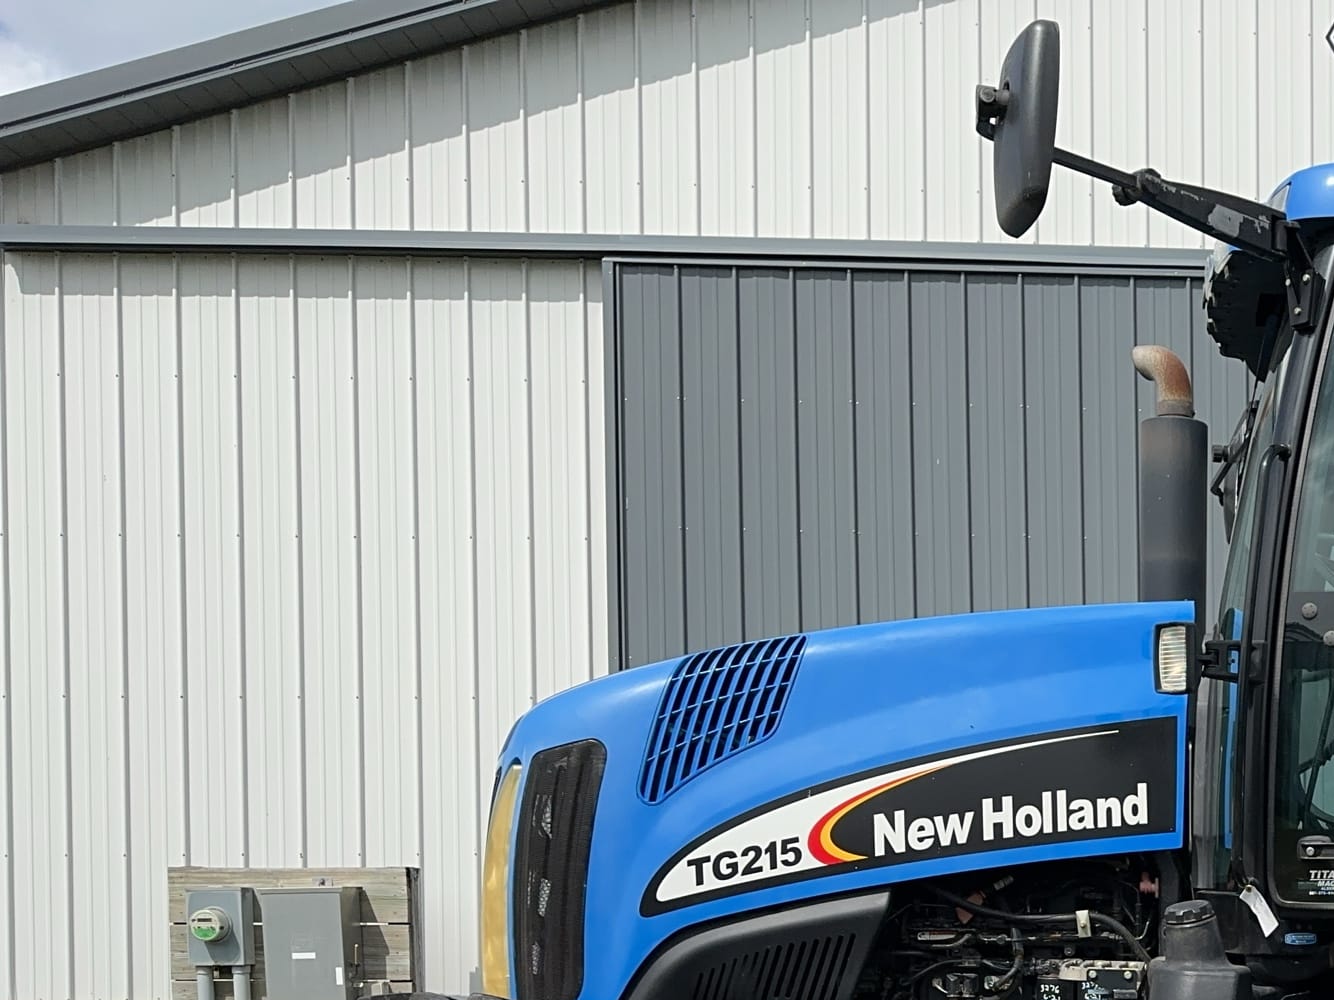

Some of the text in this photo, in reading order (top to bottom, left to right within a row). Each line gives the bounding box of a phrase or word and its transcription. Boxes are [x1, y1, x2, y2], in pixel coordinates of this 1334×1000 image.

[873, 783, 1149, 857] New Holland
[687, 836, 801, 887] TG215
